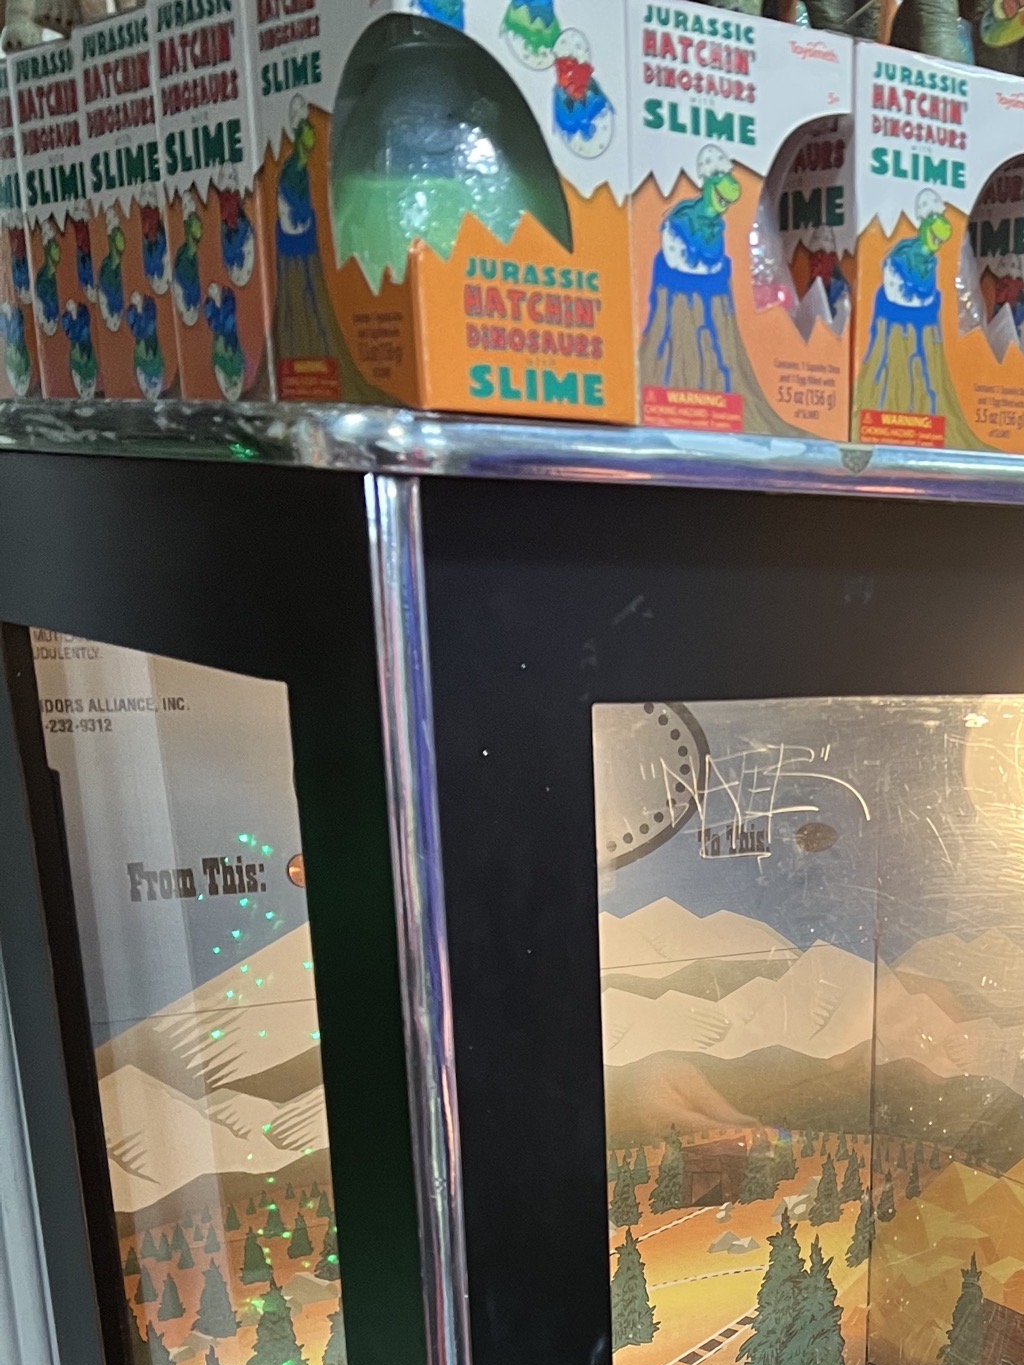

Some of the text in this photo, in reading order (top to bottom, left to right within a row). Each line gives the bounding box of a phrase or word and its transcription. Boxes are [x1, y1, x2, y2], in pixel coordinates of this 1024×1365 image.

[82, 16, 148, 62] JURASSIC
[643, 5, 756, 45] JURASSIC
[16, 47, 72, 84] JURASSI
[261, 50, 322, 96] SLIME
[642, 28, 756, 76] HATCHIN'
[83, 51, 150, 105] HATCHIN
[161, 68, 239, 117] DINOSAURS
[642, 62, 756, 104] DINOSAURS
[873, 61, 968, 96] JURASSIC
[18, 78, 78, 124] HATCHIN
[643, 98, 756, 146] SLIME
[872, 82, 968, 125] HATCHIN'
[21, 120, 80, 156] DINOSAUR
[165, 118, 243, 176] SLIME
[872, 115, 967, 150] DINOSAURS
[91, 141, 160, 193] SLIME
[870, 147, 966, 189] SLIME
[779, 186, 844, 232] IME
[465, 257, 600, 292] JURASSIC
[463, 283, 602, 329] HATCHIN'
[465, 323, 604, 360] DINOSAURS
[468, 363, 605, 407] SLIME
[42, 697, 190, 714] DORS ALLIANCE, INC.
[127, 856, 267, 902] From This:
